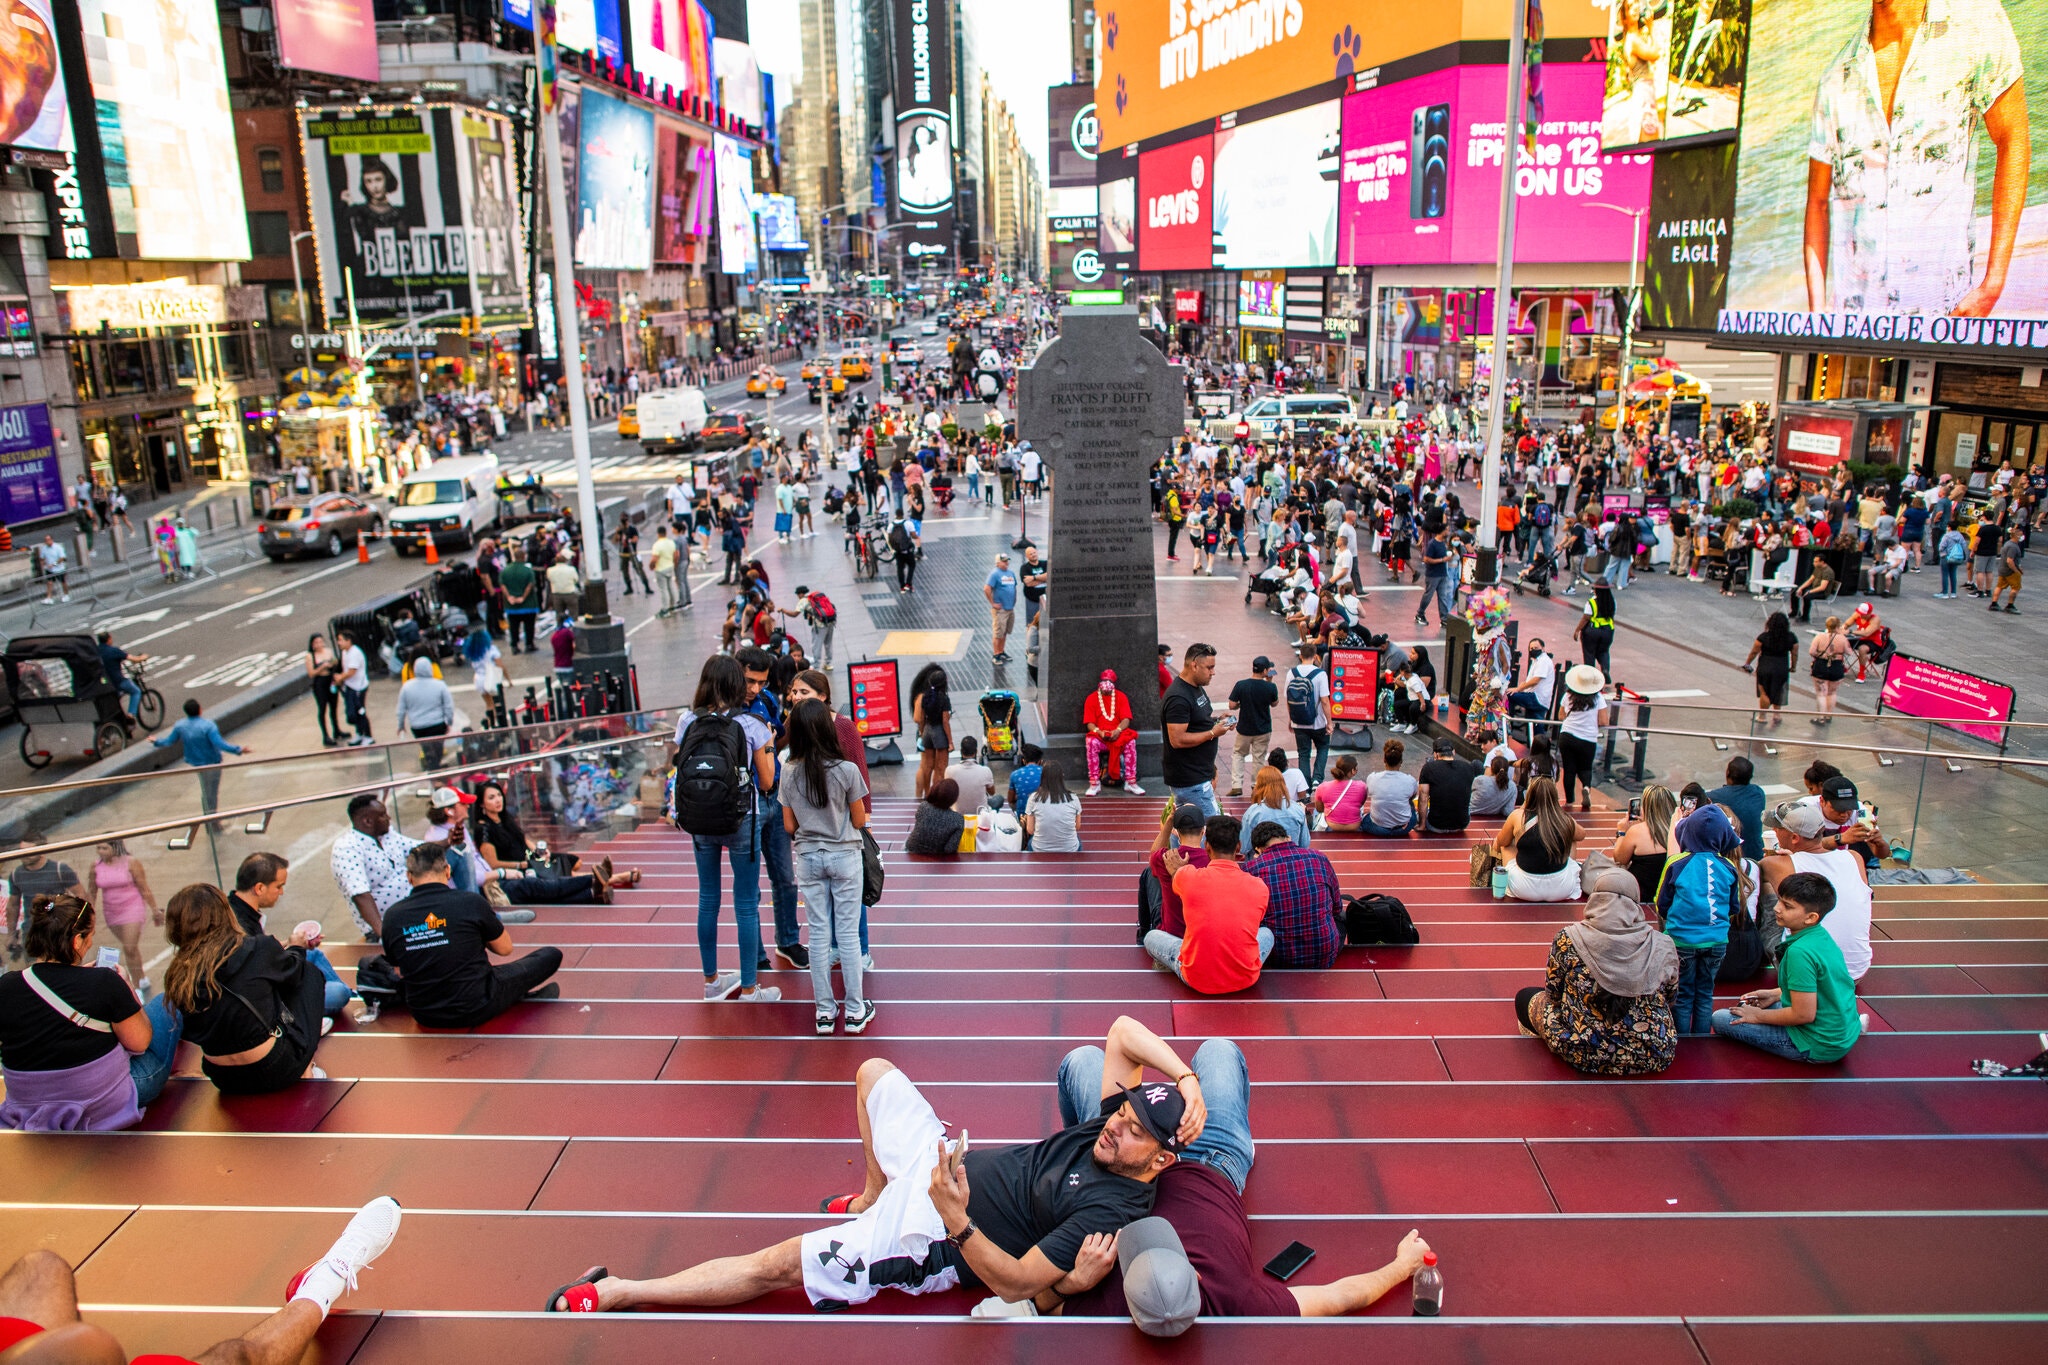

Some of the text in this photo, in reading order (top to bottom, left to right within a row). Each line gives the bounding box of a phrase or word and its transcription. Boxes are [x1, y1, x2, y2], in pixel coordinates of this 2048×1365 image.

[911, 0, 931, 103] BILLIONS CL
[1159, 29, 1199, 90] INTO
[1202, 0, 1304, 73] MONDAYS
[1470, 122, 1507, 137] SWITC
[1542, 122, 1566, 135] GET
[1566, 136, 1599, 165] 12
[1515, 167, 1604, 196] ON US
[1657, 217, 1728, 239] AMERICA
[1671, 244, 1720, 264] EAGLE
[138, 298, 212, 320] EXPRESS
[1720, 310, 1835, 339] AMERICAN
[1844, 314, 1924, 343] EAGLE
[290, 333, 343, 350] GFTS
[1051, 393, 1099, 405] FRANCIS
[1113, 393, 1153, 404] DUFFY
[1064, 420, 1102, 428] CATHOLIC
[1, 446, 53, 466] RESTAURANT
[1, 460, 44, 479] AVAILABLE
[1075, 482, 1091, 490] LIFE
[1107, 481, 1140, 490] SERVICE
[1104, 497, 1143, 506] COUNTRY
